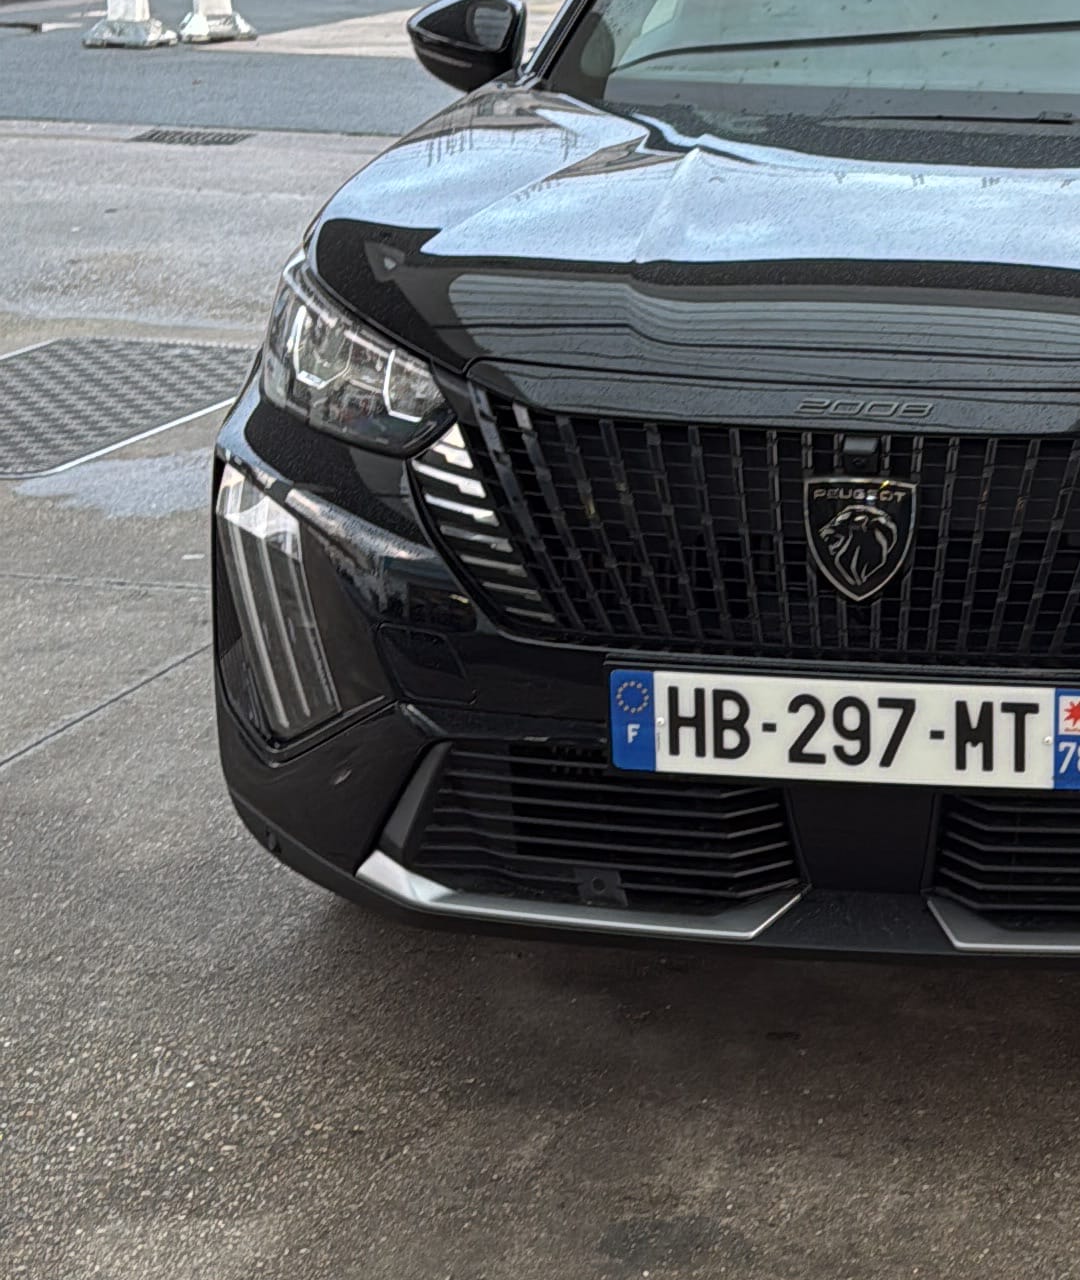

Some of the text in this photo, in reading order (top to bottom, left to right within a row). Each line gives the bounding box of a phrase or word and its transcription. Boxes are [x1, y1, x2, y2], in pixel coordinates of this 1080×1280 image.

[794, 397, 934, 418] 2008
[813, 486, 907, 503] PEUGEOT
[626, 723, 641, 744] F
[667, 685, 1040, 774] HB-297-MT
